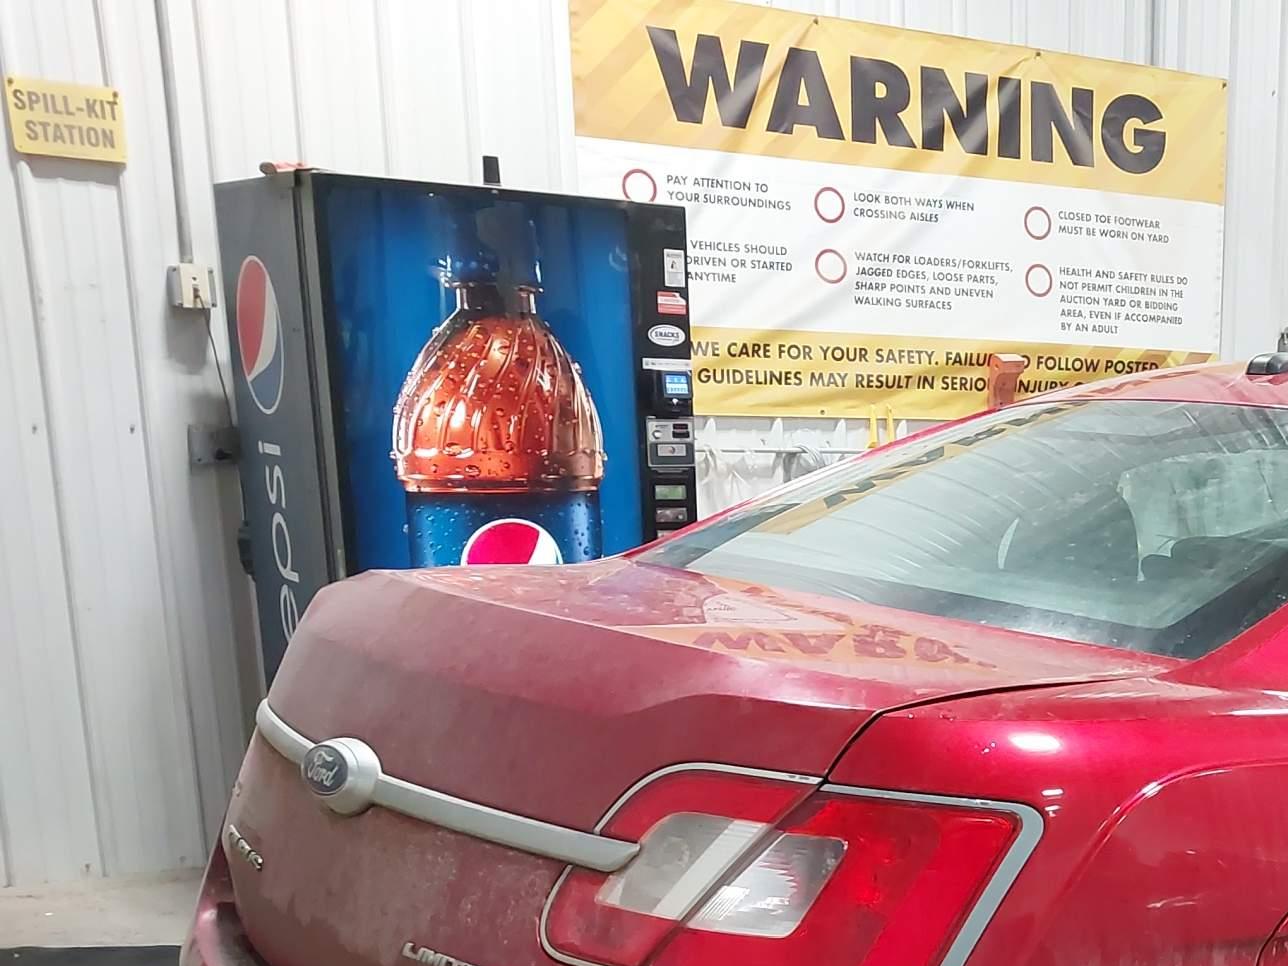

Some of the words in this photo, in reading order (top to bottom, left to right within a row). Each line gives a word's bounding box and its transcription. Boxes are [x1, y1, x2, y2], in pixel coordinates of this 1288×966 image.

[12, 89, 118, 121] SPILL-KIT
[646, 25, 1167, 175] WARNING
[25, 120, 116, 149] STATION
[667, 175, 688, 185] PAY
[693, 178, 751, 191] ATTENTION
[755, 183, 769, 193] TO
[667, 191, 700, 203] YOUR
[702, 194, 791, 211] SURROUNDINGS
[854, 192, 881, 204] LOOK
[884, 195, 911, 206] BOTH
[914, 198, 943, 209] WAYS
[945, 200, 974, 211] WHEN
[853, 207, 906, 220] CROSSING
[909, 212, 939, 223] AISLES
[1058, 211, 1092, 222] CLOSED
[1095, 214, 1111, 224] TOE
[1114, 216, 1160, 229] FOOTWEAR
[1058, 225, 1083, 235] MUST
[1086, 227, 1096, 237] BE
[1099, 229, 1128, 240] WORN
[1131, 231, 1144, 241] ON
[1146, 233, 1169, 243] YARD
[690, 240, 740, 253] VEHICLES
[744, 244, 787, 256] SHOULD
[731, 258, 746, 268] OR
[750, 260, 792, 271] STARTED
[854, 251, 890, 263] WATCH
[892, 254, 911, 265] FOR
[687, 272, 736, 283] ANYTIME
[855, 267, 893, 278] JAGGED
[896, 269, 930, 282] EDGES,
[933, 271, 964, 282] LOOSE
[967, 274, 999, 286] PARTS,
[1059, 267, 1092, 278] HEALTH
[1095, 270, 1115, 280] AND
[1118, 271, 1148, 283] SAFETY
[1150, 274, 1175, 284] RULES
[1177, 276, 1188, 285] DO
[854, 281, 887, 292] SHARP
[889, 284, 926, 294] POINTS
[929, 286, 951, 296] AND
[954, 288, 994, 299] UNEVEN
[1059, 281, 1079, 291] NOT
[1081, 282, 1113, 293] PERMIT
[1115, 285, 1157, 296] CHILDREN
[1159, 288, 1168, 297] IN
[1171, 289, 1184, 299] THE
[854, 296, 902, 308] WALKING
[905, 299, 953, 311] SURFACES
[1059, 295, 1100, 306] AUCTION
[1103, 297, 1126, 307] YARD
[1129, 299, 1142, 309] OR
[1144, 301, 1178, 312] BIDDING
[1060, 309, 1087, 320] AREA,
[1089, 310, 1112, 320] EVEN
[1114, 312, 1122, 321] IF
[1124, 313, 1183, 325] ACCOMPANIED
[1060, 322, 1071, 331] BY
[1075, 324, 1089, 333] AN
[1091, 325, 1118, 334] ADULT
[692, 341, 720, 357] WE
[727, 342, 771, 359] CARE
[778, 344, 813, 360] FOR
[819, 346, 869, 363] YOUR
[874, 348, 940, 366] SAFETY.
[944, 351, 993, 367] FAILU
[1037, 355, 1100, 373] FOLLOW
[697, 368, 801, 386] GUIDELINES
[809, 372, 848, 388] MAY
[855, 374, 913, 390] RESULT
[917, 375, 935, 390] IN
[940, 376, 990, 392] SERIO
[258, 440, 300, 643] epsi
[307, 751, 339, 787] Ford
